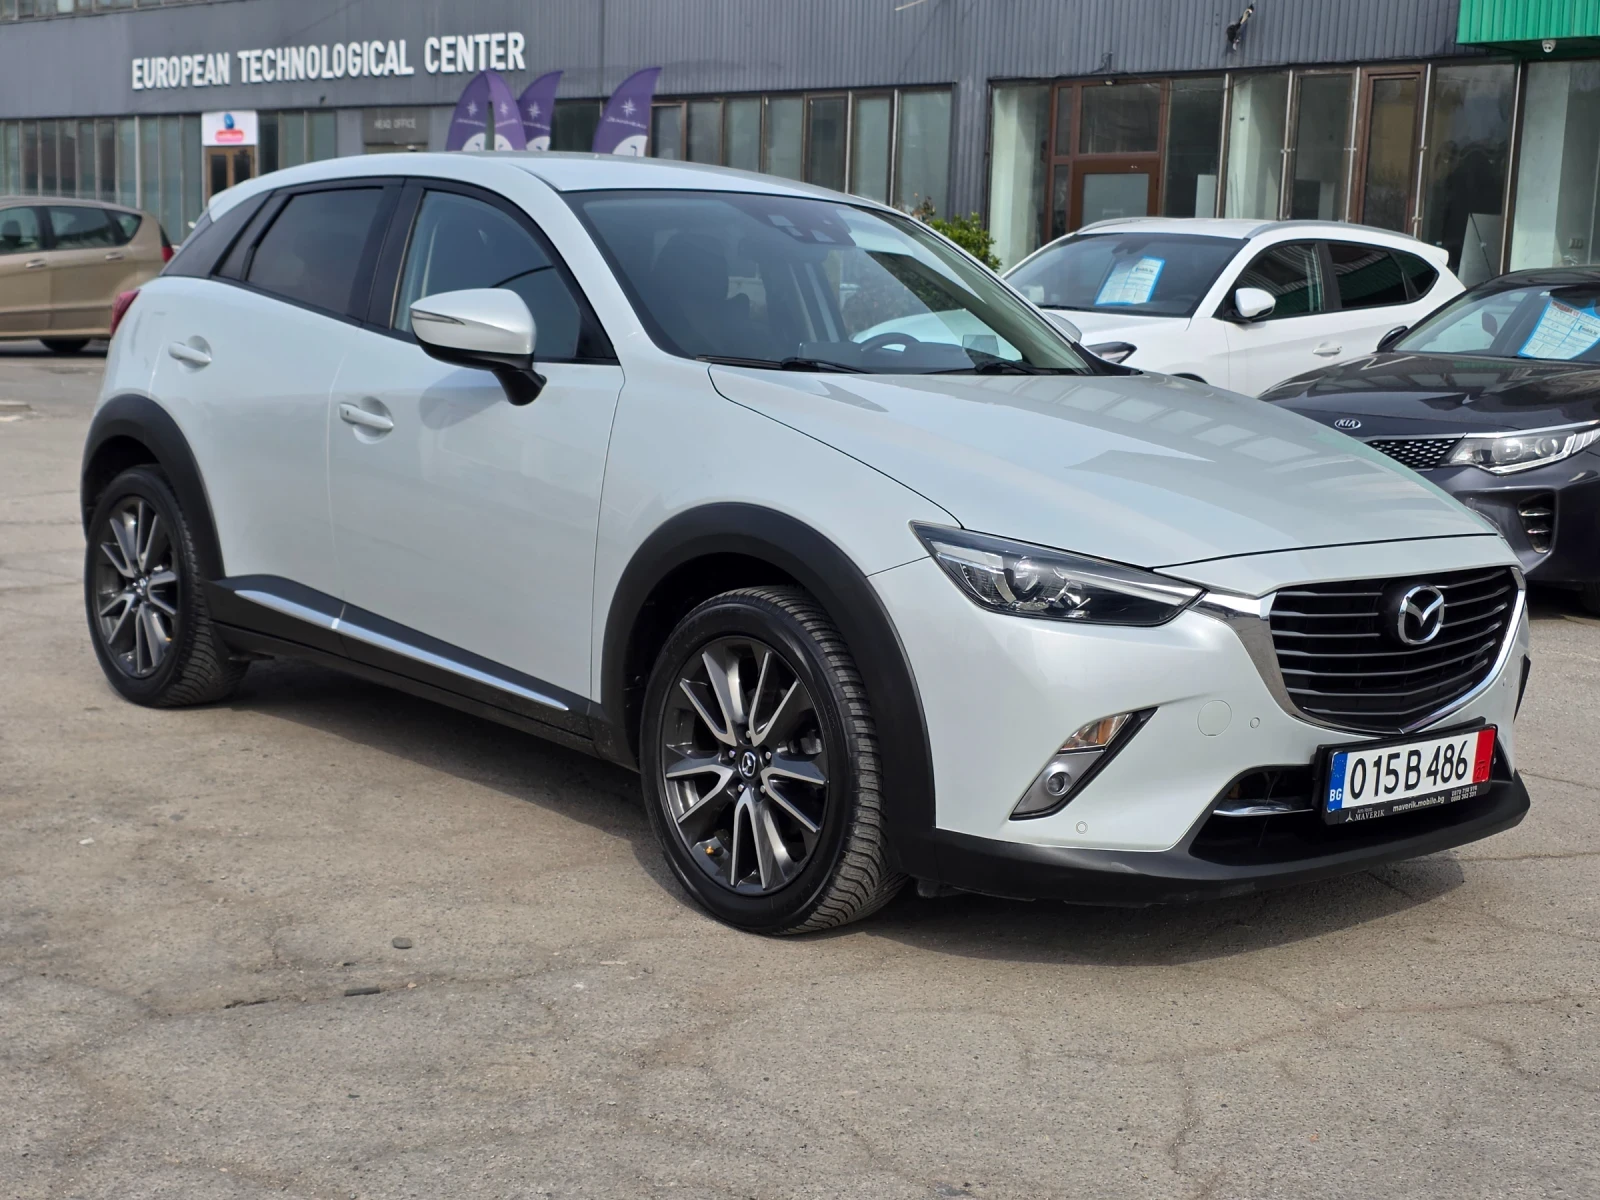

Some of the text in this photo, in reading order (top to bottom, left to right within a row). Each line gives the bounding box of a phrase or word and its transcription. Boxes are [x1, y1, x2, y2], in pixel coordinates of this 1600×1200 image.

[132, 32, 526, 90] EUROPEAN TECHNOLOGICAL CENTER
[393, 118, 416, 129] OFFICE
[1329, 788, 1343, 802] BG
[1392, 795, 1445, 812] maverik.mobile.bg
[1354, 809, 1385, 821] MAVERIK
